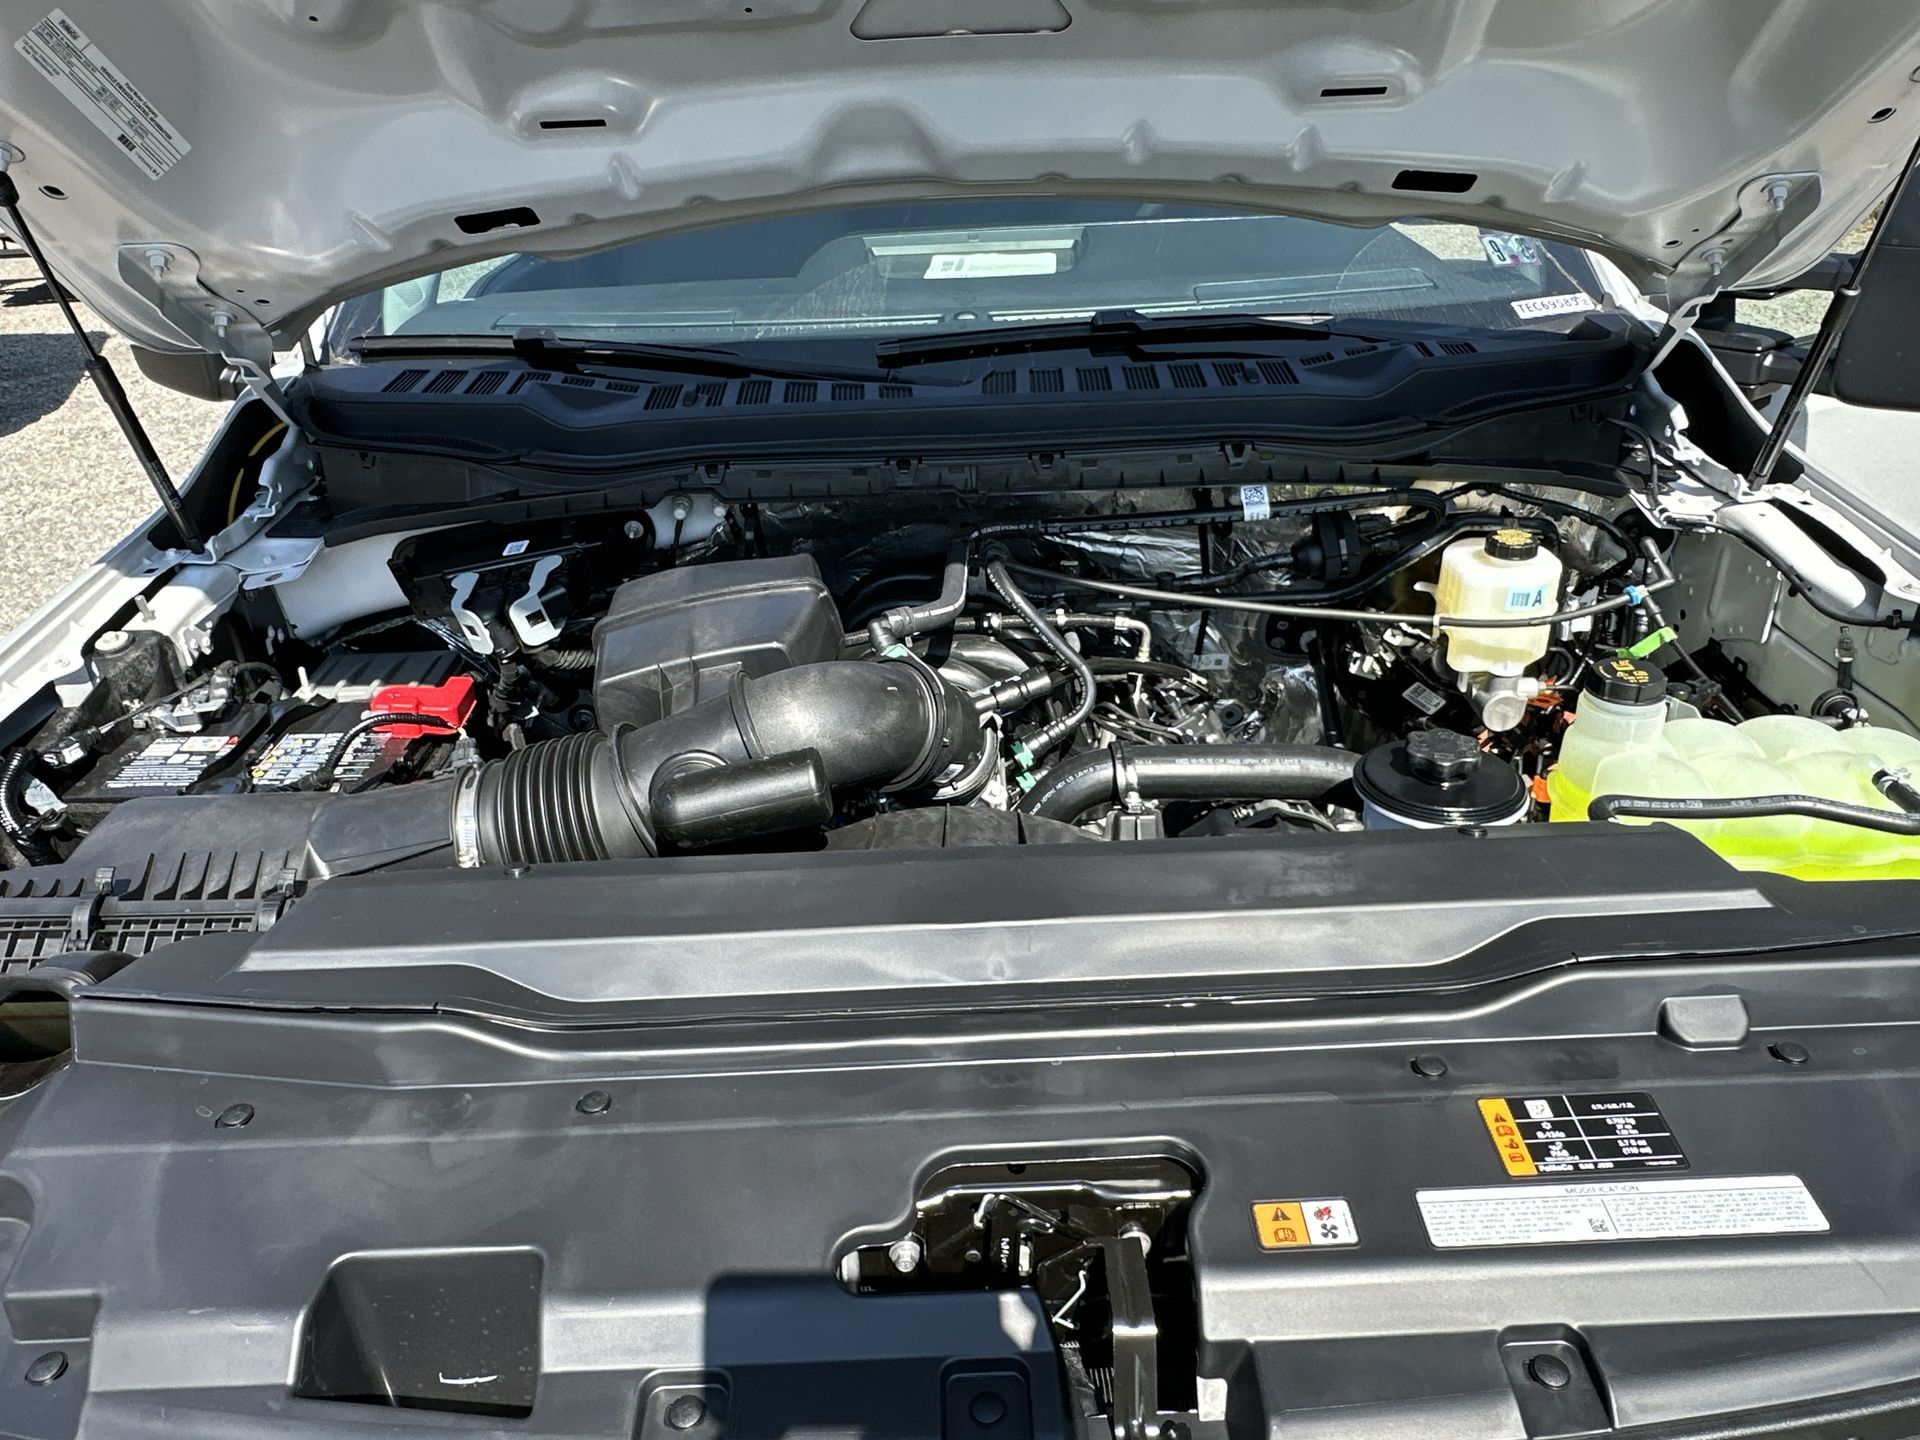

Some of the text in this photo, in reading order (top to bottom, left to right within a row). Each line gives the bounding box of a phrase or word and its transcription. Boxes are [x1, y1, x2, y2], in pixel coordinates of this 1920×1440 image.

[98, 65, 117, 84] VEHICLE
[131, 99, 150, 118] CONTROL
[1489, 240, 1506, 261] 9
[1532, 589, 1542, 607] A
